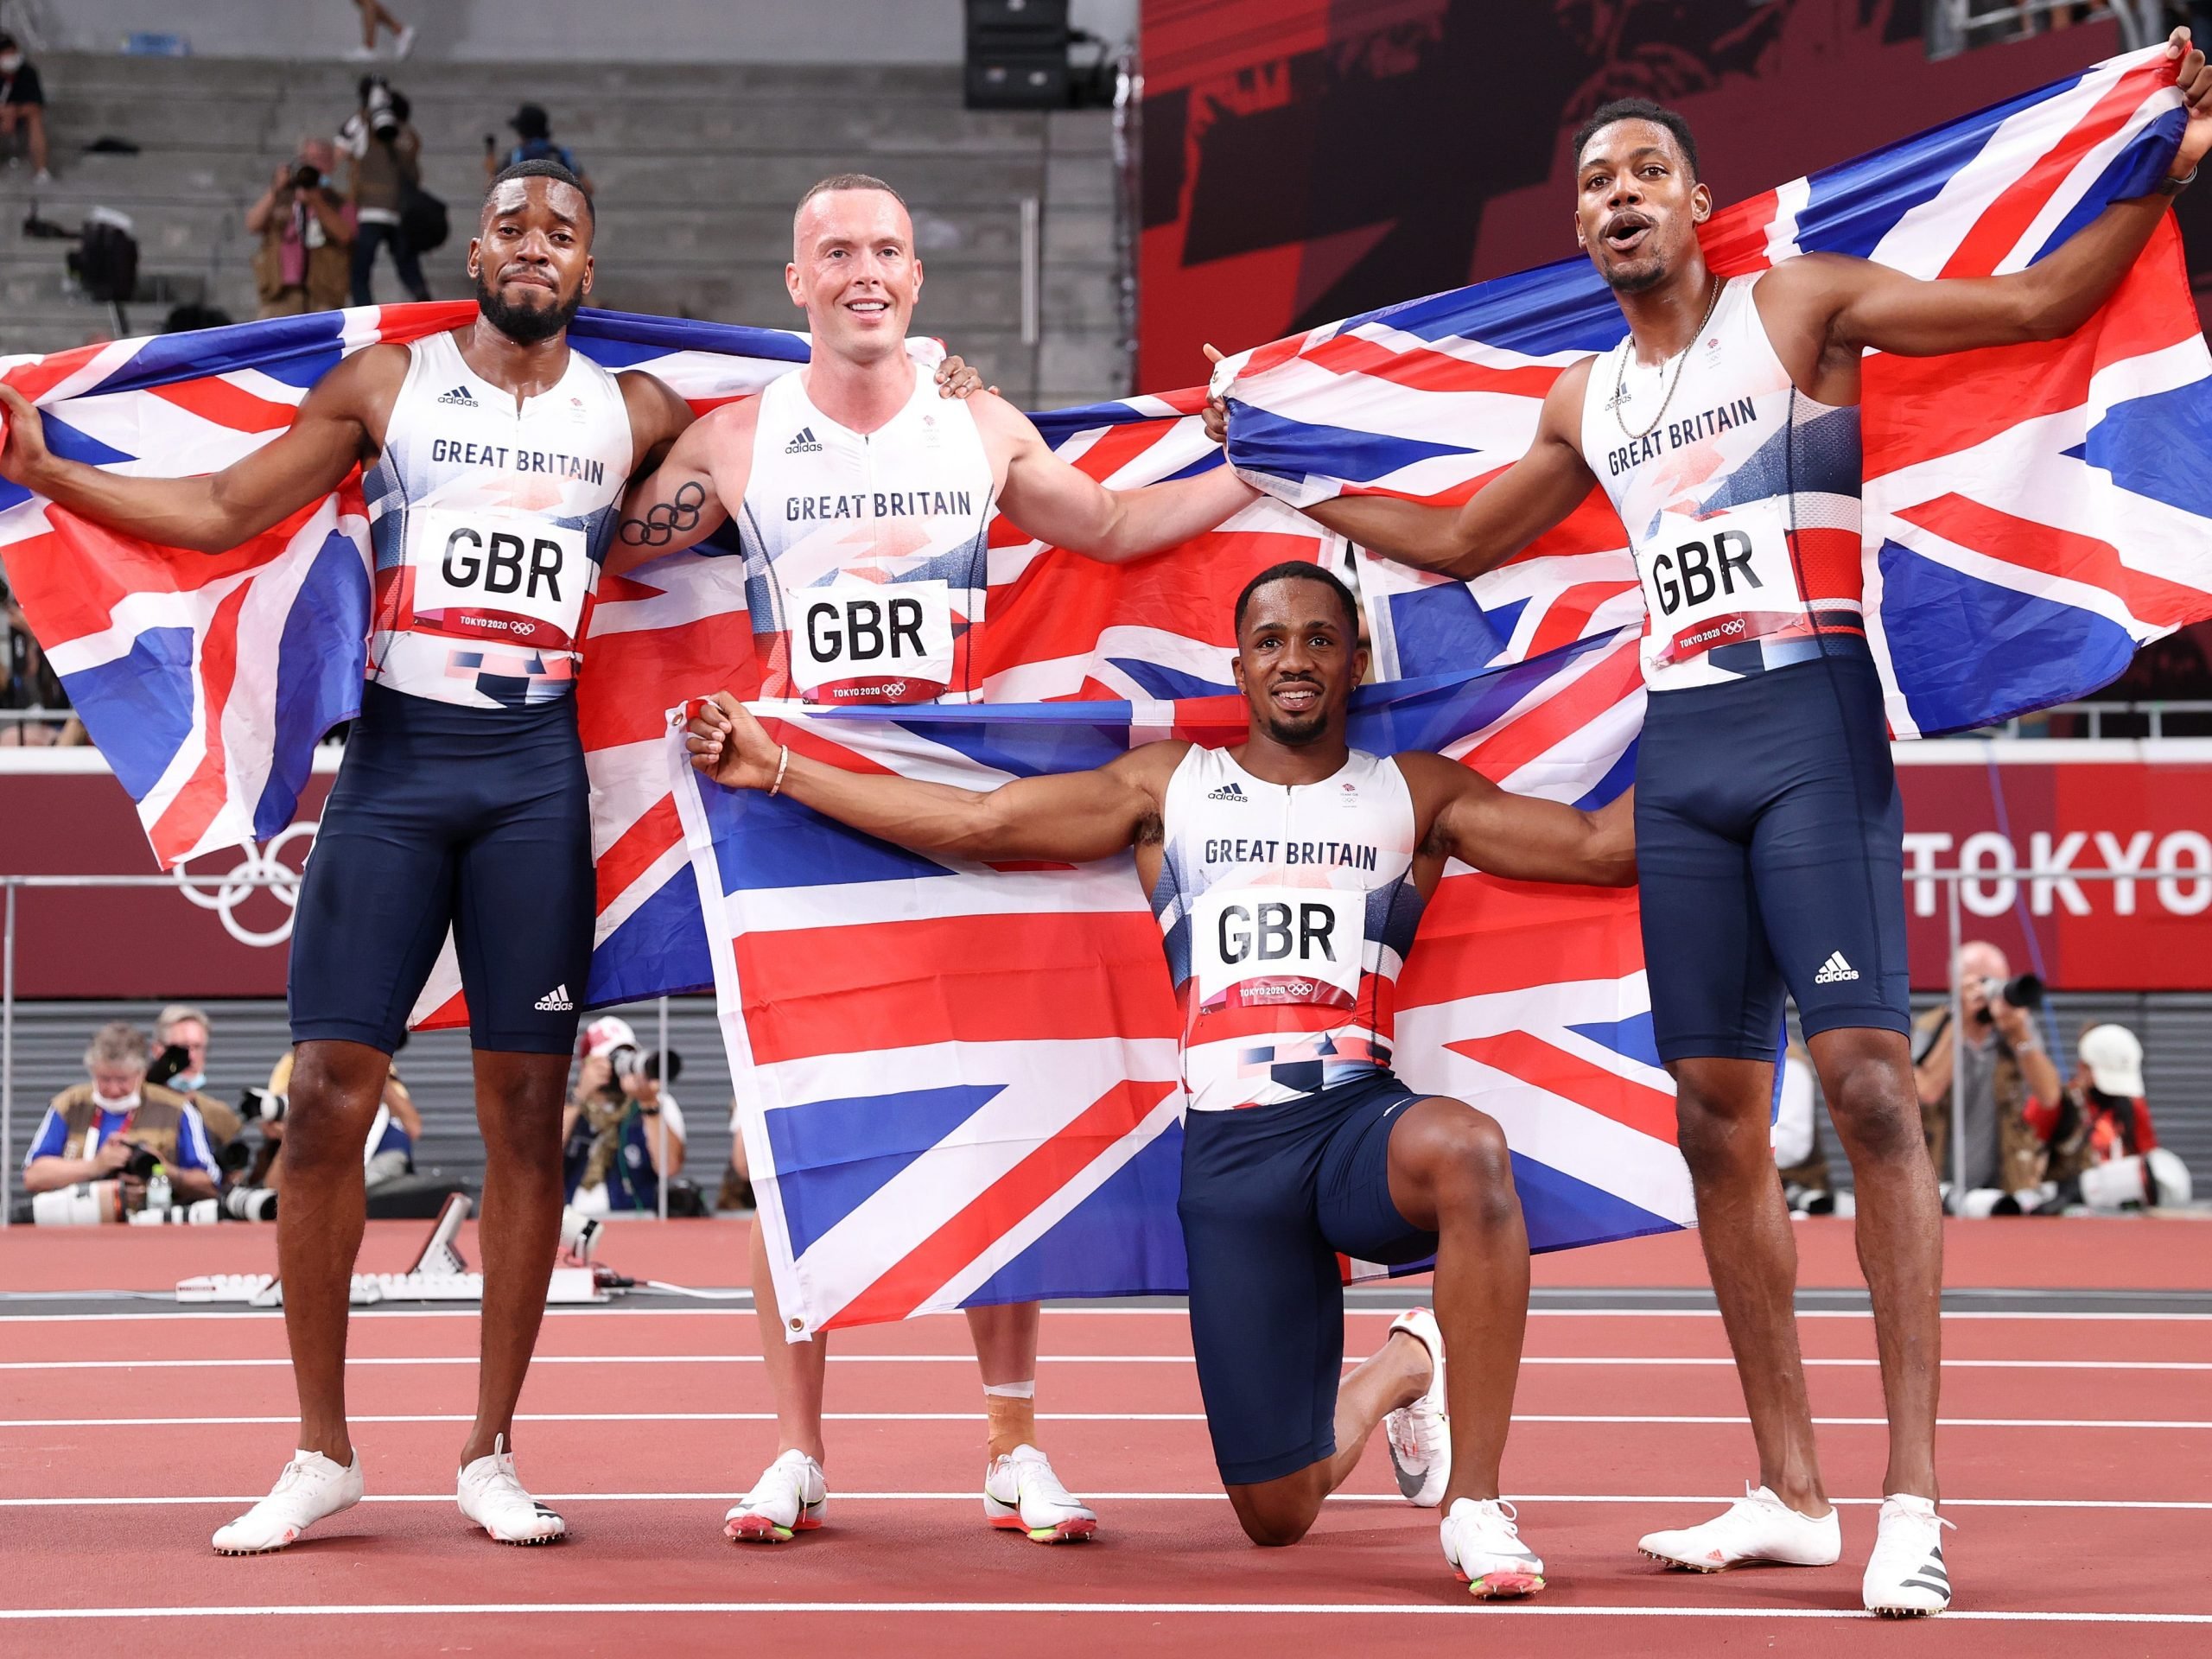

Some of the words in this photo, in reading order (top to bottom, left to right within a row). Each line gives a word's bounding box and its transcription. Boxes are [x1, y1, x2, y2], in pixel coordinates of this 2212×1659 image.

[437, 396, 479, 408] adidas
[1605, 394, 1632, 411] addas
[1608, 429, 1662, 477] GREAT
[1669, 396, 1758, 449] BRITAIN
[785, 442, 823, 454] adidas
[432, 439, 509, 468] GREAT
[516, 449, 604, 486] BRITAIN
[786, 494, 866, 521] GREAT
[874, 491, 971, 518] BRITAIN
[442, 527, 563, 602] GBR
[1652, 530, 1764, 616] GBR
[460, 616, 486, 628] TOKYO
[486, 620, 508, 630] 2020
[807, 598, 927, 663] GBR
[1679, 635, 1702, 649] TOKYO
[1702, 628, 1720, 641] 2020
[832, 688, 860, 698] TOKYO
[860, 687, 880, 696] 2020
[1207, 791, 1249, 803] adidas
[1205, 839, 1280, 864] GREAT
[1286, 842, 1377, 872] BRITAIN
[1902, 830, 2212, 918] TOKYO
[1218, 902, 1338, 965] GBR
[1815, 969, 1859, 984] adidas
[1239, 988, 1266, 997] TOKYO
[1266, 985, 1286, 995] 2020
[534, 1001, 574, 1011] adidas
